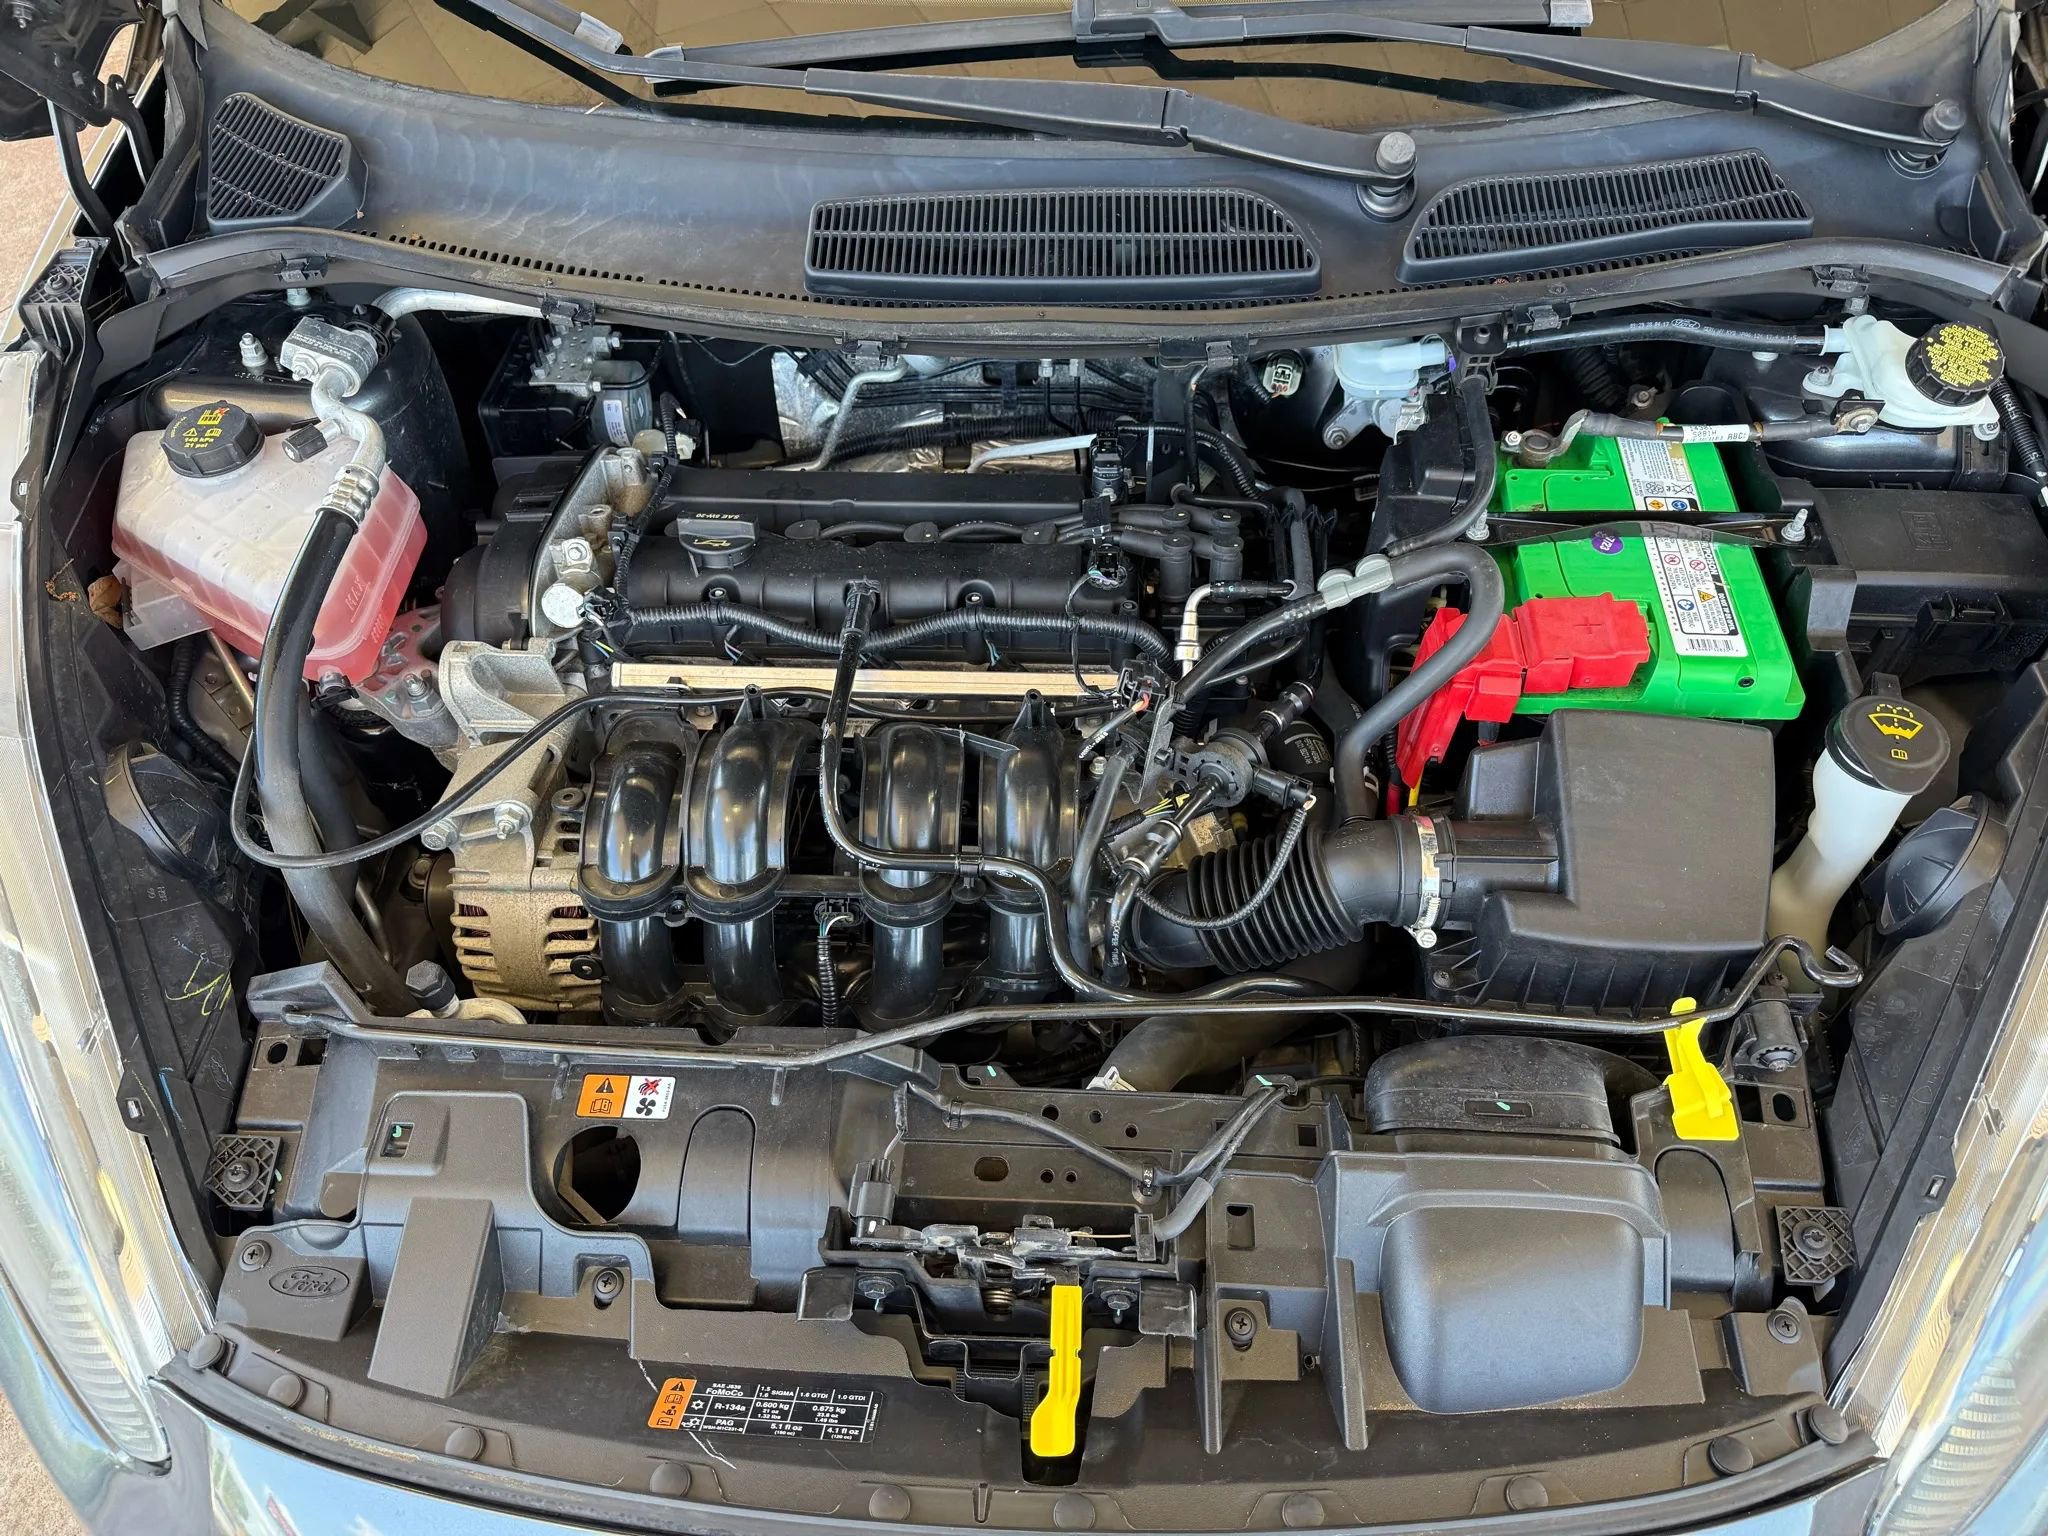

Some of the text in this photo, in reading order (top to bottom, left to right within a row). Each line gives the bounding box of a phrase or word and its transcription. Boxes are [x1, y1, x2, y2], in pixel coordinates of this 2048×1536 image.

[1700, 541, 1718, 574] R/POISON
[280, 1268, 339, 1293] Ford
[705, 1387, 744, 1397] FoMoCo
[714, 1402, 746, 1411] R-134a
[755, 1401, 790, 1411] 0.600 kg
[835, 1405, 847, 1415] kg
